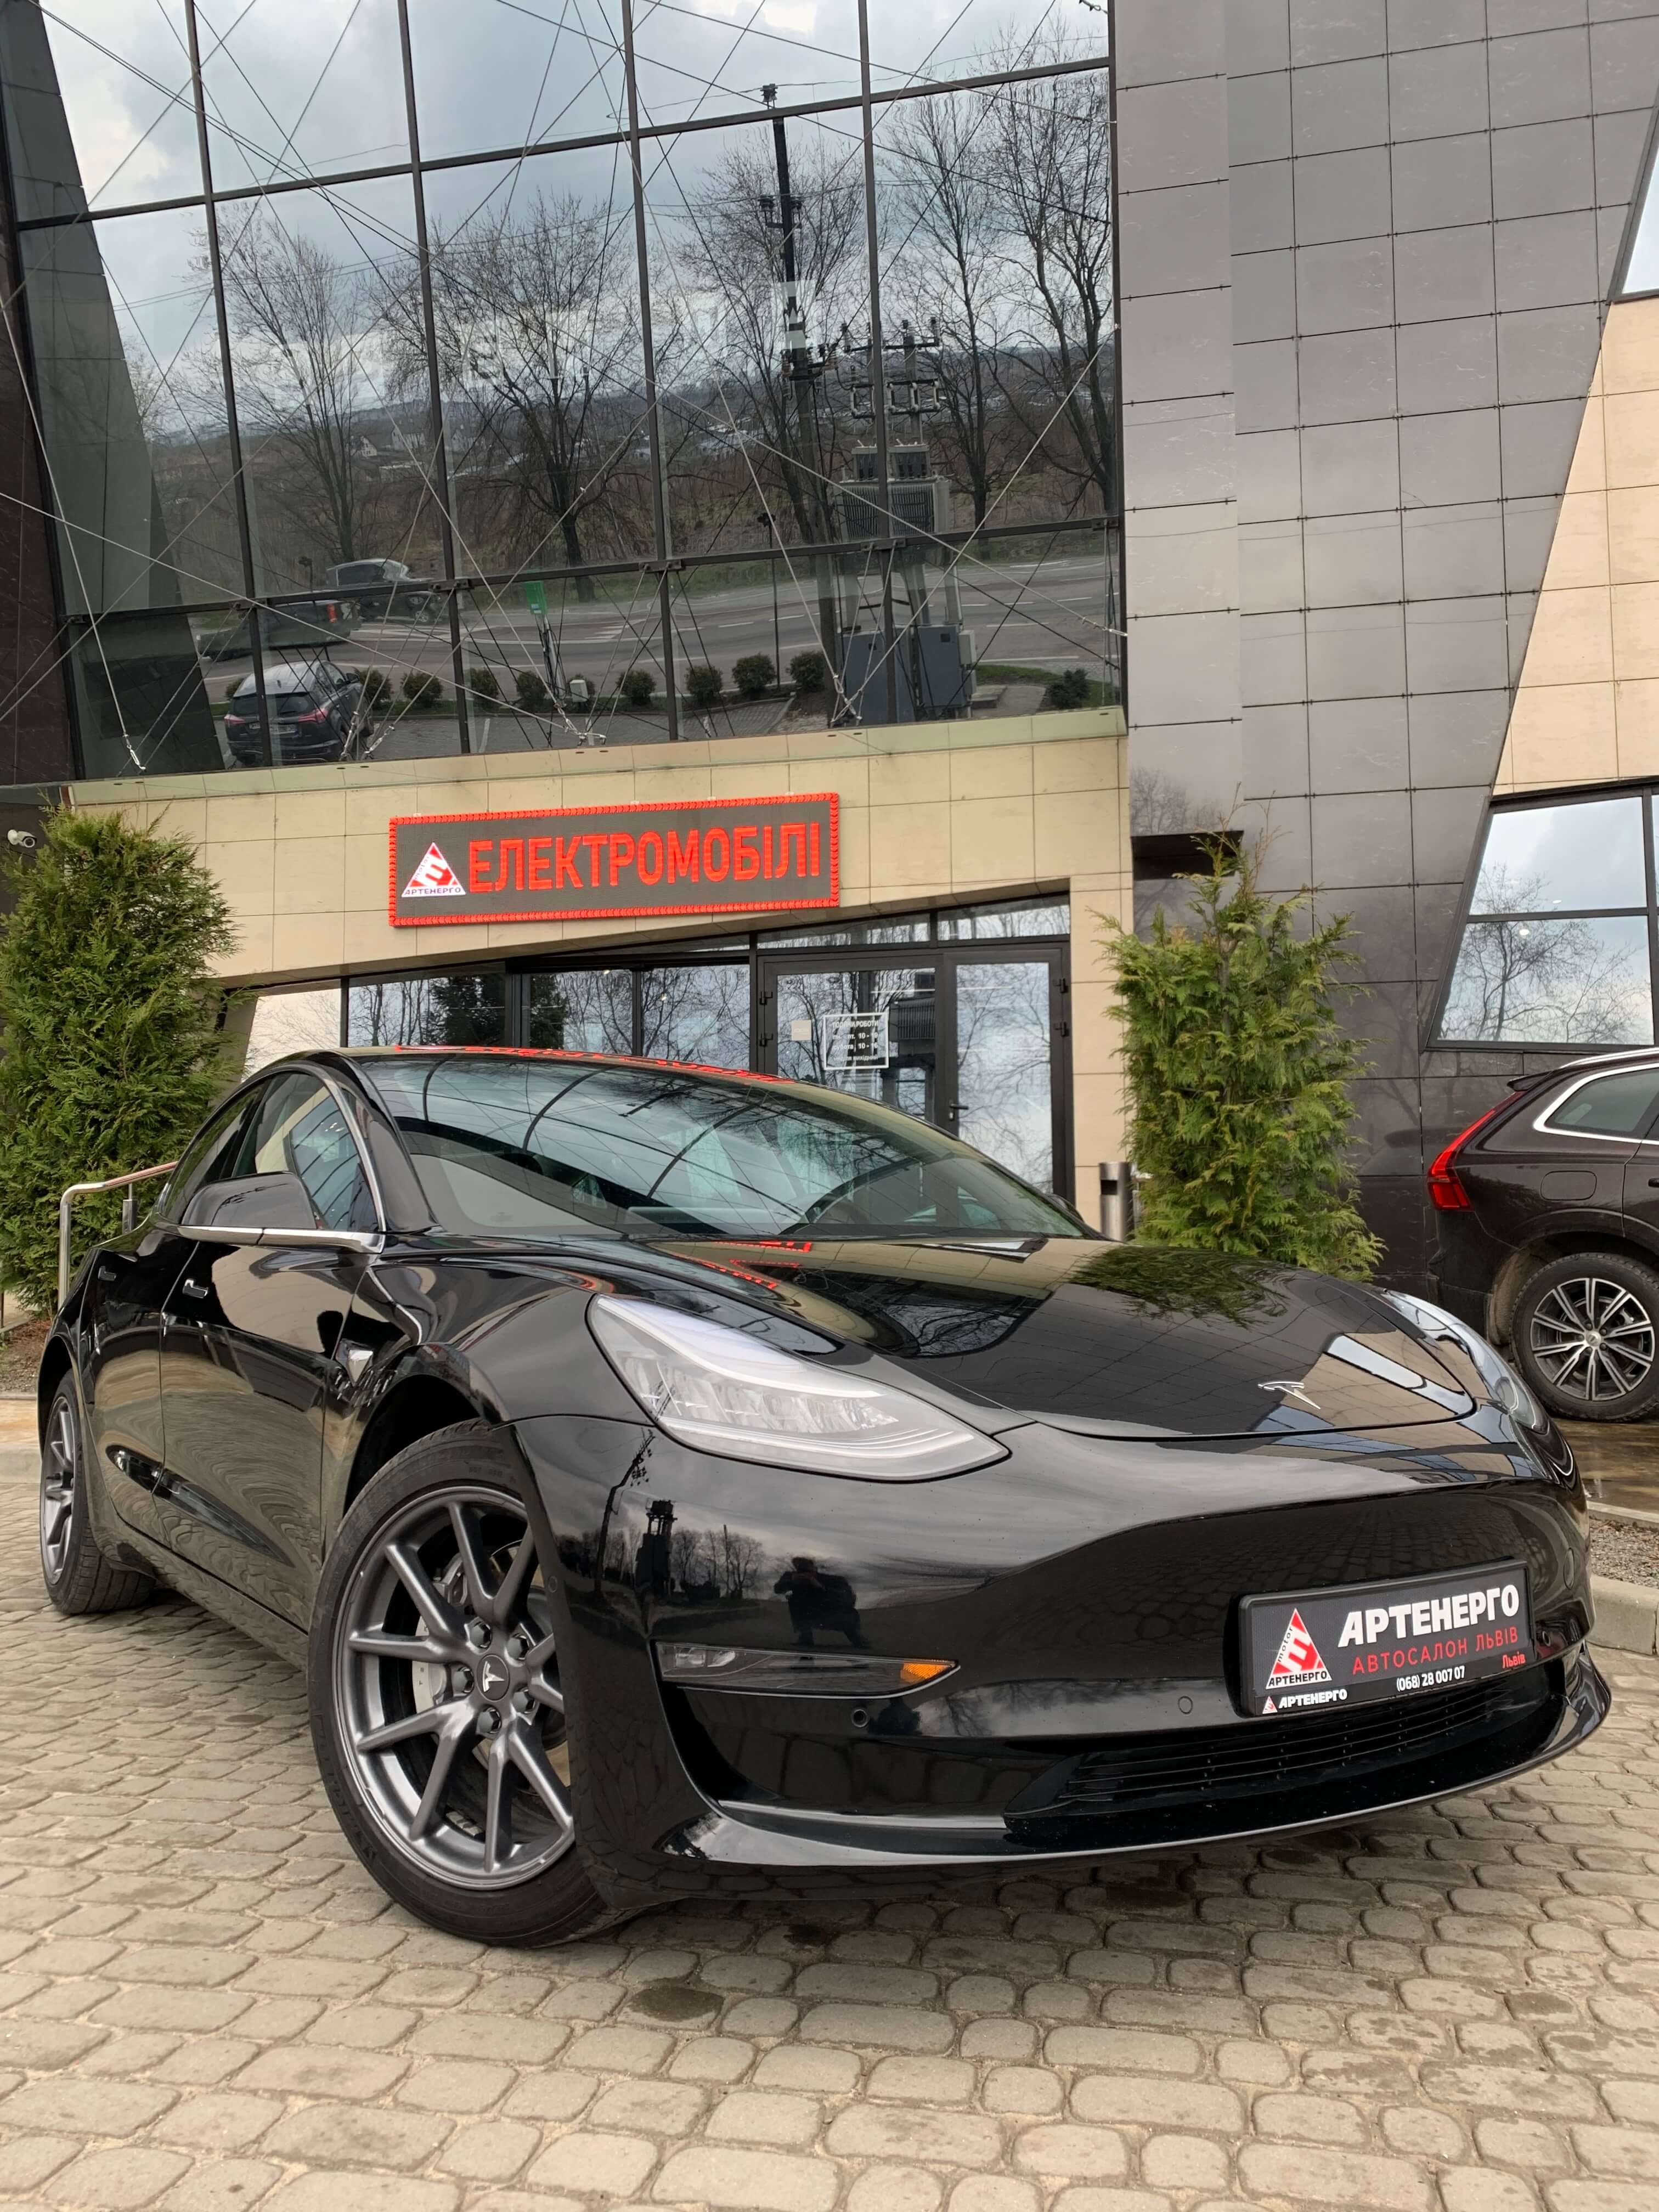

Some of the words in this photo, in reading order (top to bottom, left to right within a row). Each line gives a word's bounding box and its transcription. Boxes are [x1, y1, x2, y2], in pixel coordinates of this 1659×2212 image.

[469, 822, 820, 893] ЕЛЕКТРОМОБІЛІ
[404, 887, 461, 895] АРТЕНЕРГО
[1338, 1584, 1520, 1648] АРТЕНЕРГО
[1278, 1626, 1293, 1662] motor
[1352, 1638, 1468, 1675] АВТОСАЛОН
[1476, 1626, 1519, 1652] ЛЬВІВ
[1502, 1651, 1526, 1669] Львів
[1268, 1671, 1327, 1687] АРТЕНЕРГО
[1396, 1674, 1420, 1692] (068)
[1422, 1673, 1435, 1688] 28
[1436, 1668, 1454, 1684] 007
[1454, 1665, 1466, 1680] 07
[1278, 1689, 1347, 1709] АРТЕНЕРГО
